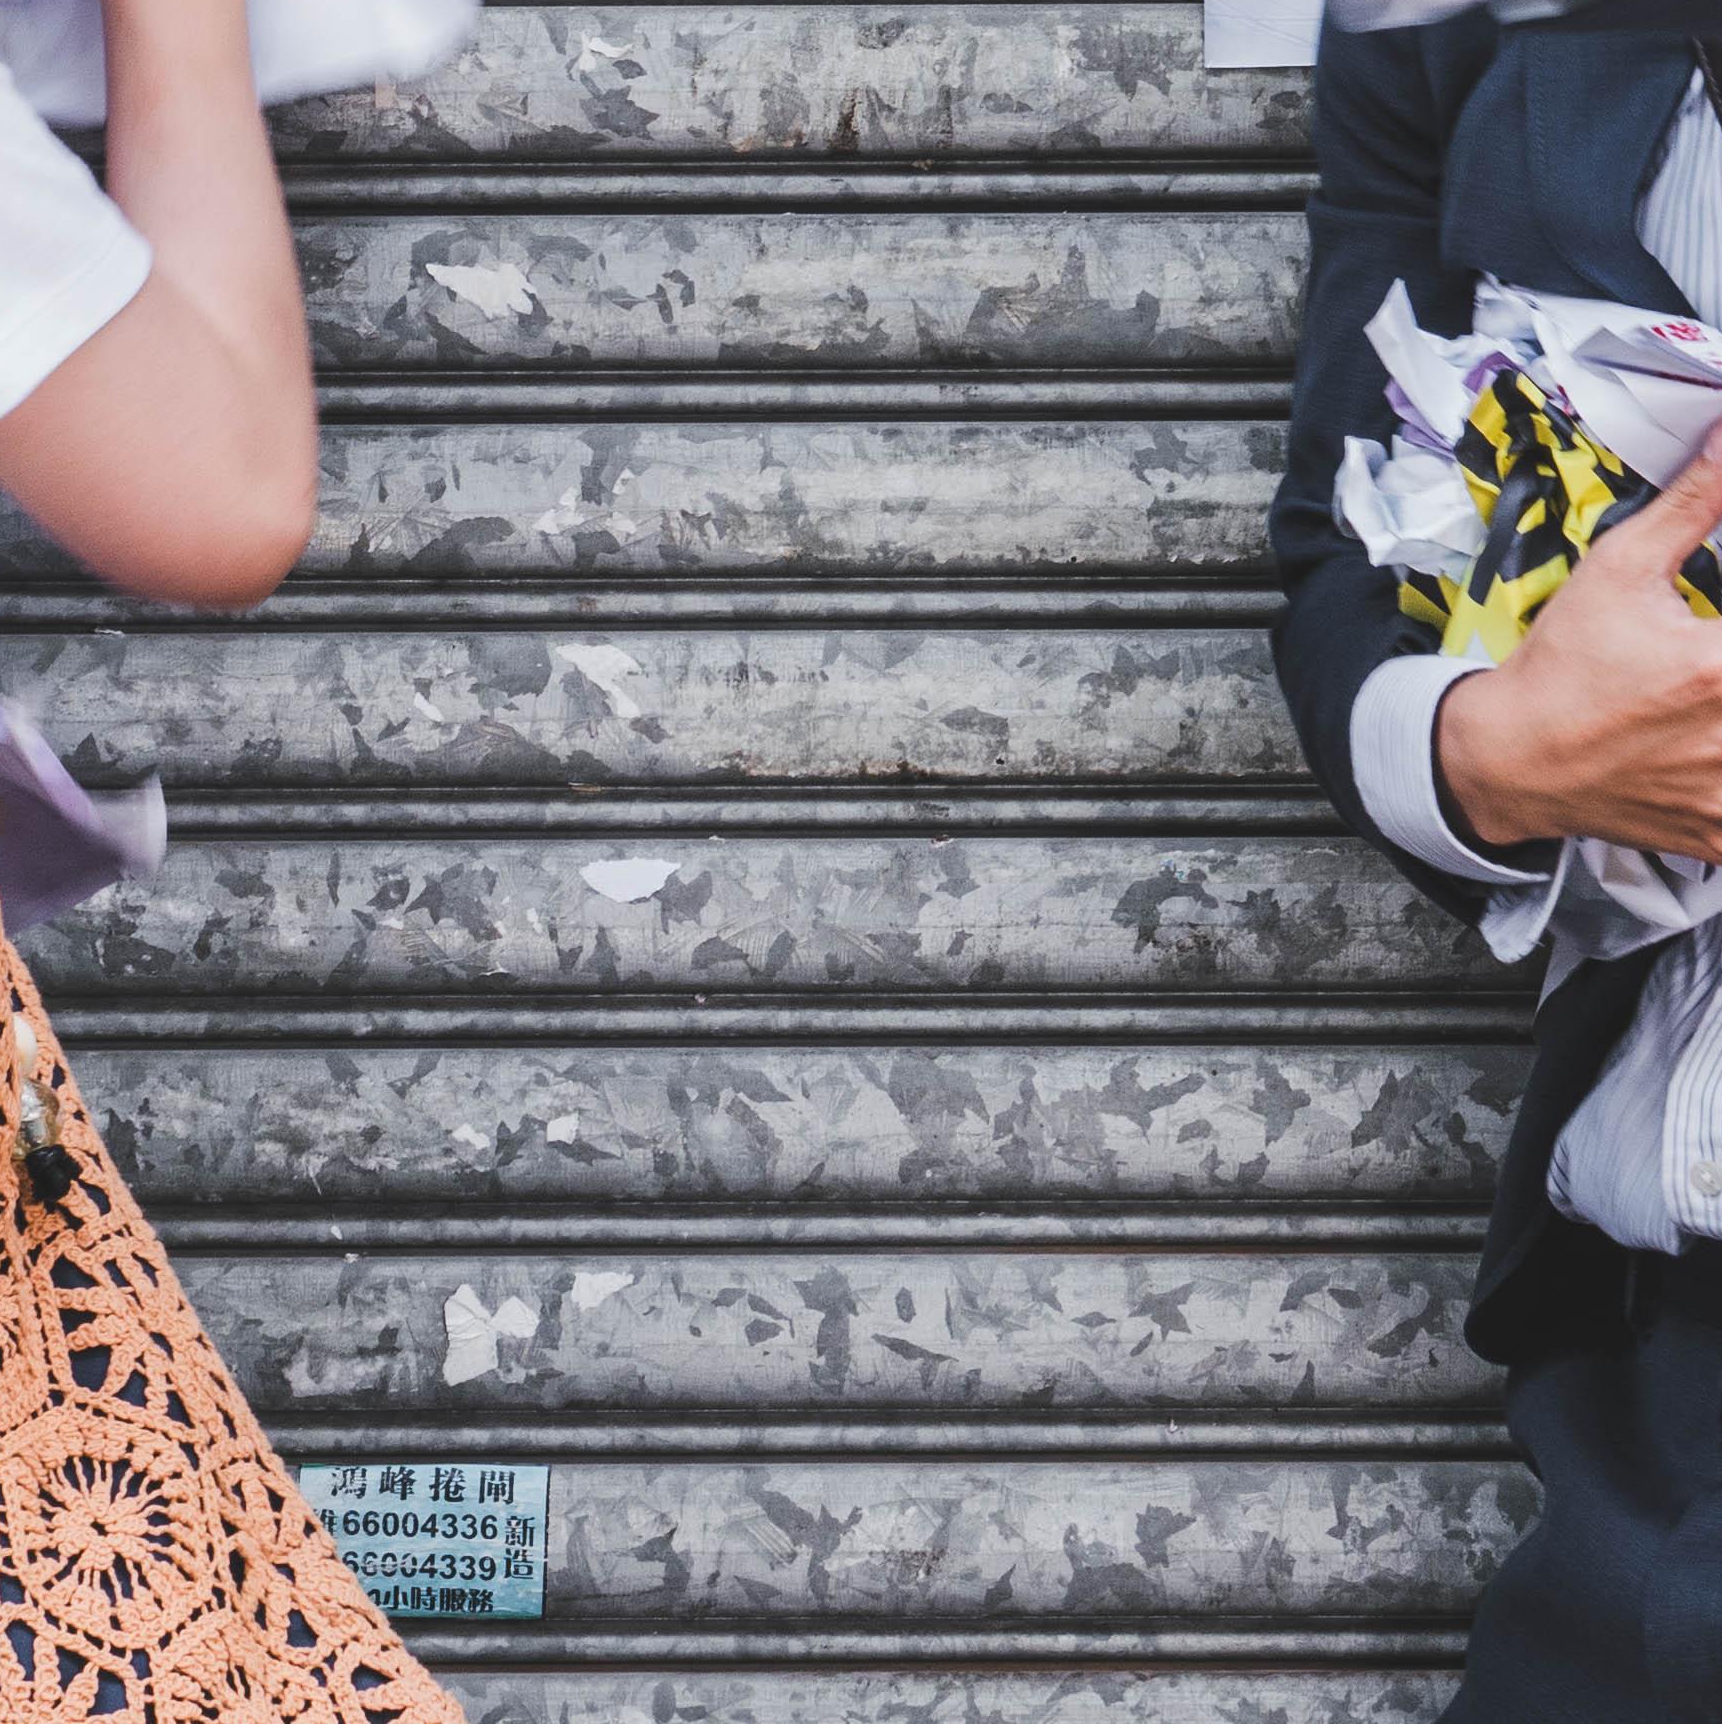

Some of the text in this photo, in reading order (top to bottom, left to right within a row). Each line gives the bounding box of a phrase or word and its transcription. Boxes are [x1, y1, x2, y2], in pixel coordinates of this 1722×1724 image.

[330, 1465, 516, 1505] 鴻峰捲閘
[342, 1510, 498, 1540] 66004336
[503, 1515, 535, 1580] 新造
